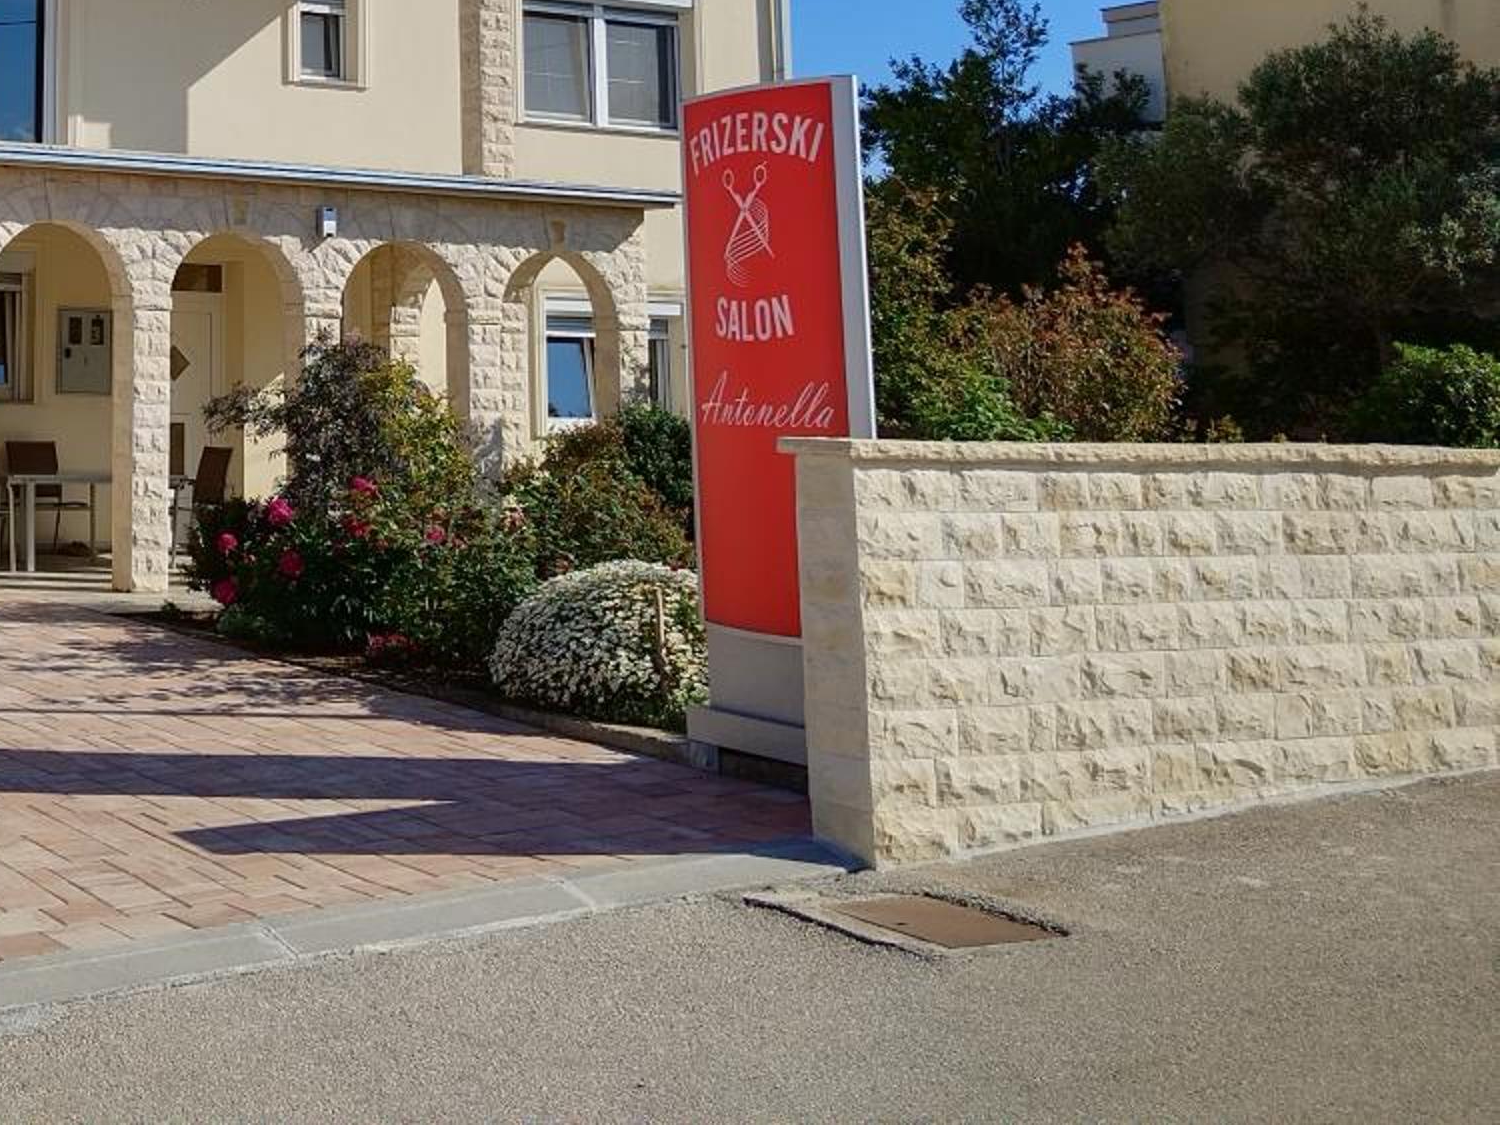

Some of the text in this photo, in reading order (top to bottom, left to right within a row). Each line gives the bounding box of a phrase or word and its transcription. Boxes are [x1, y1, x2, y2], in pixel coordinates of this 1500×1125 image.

[689, 111, 825, 176] FRIZERSKI
[716, 295, 794, 341] SALON
[701, 371, 836, 428] Antonella
